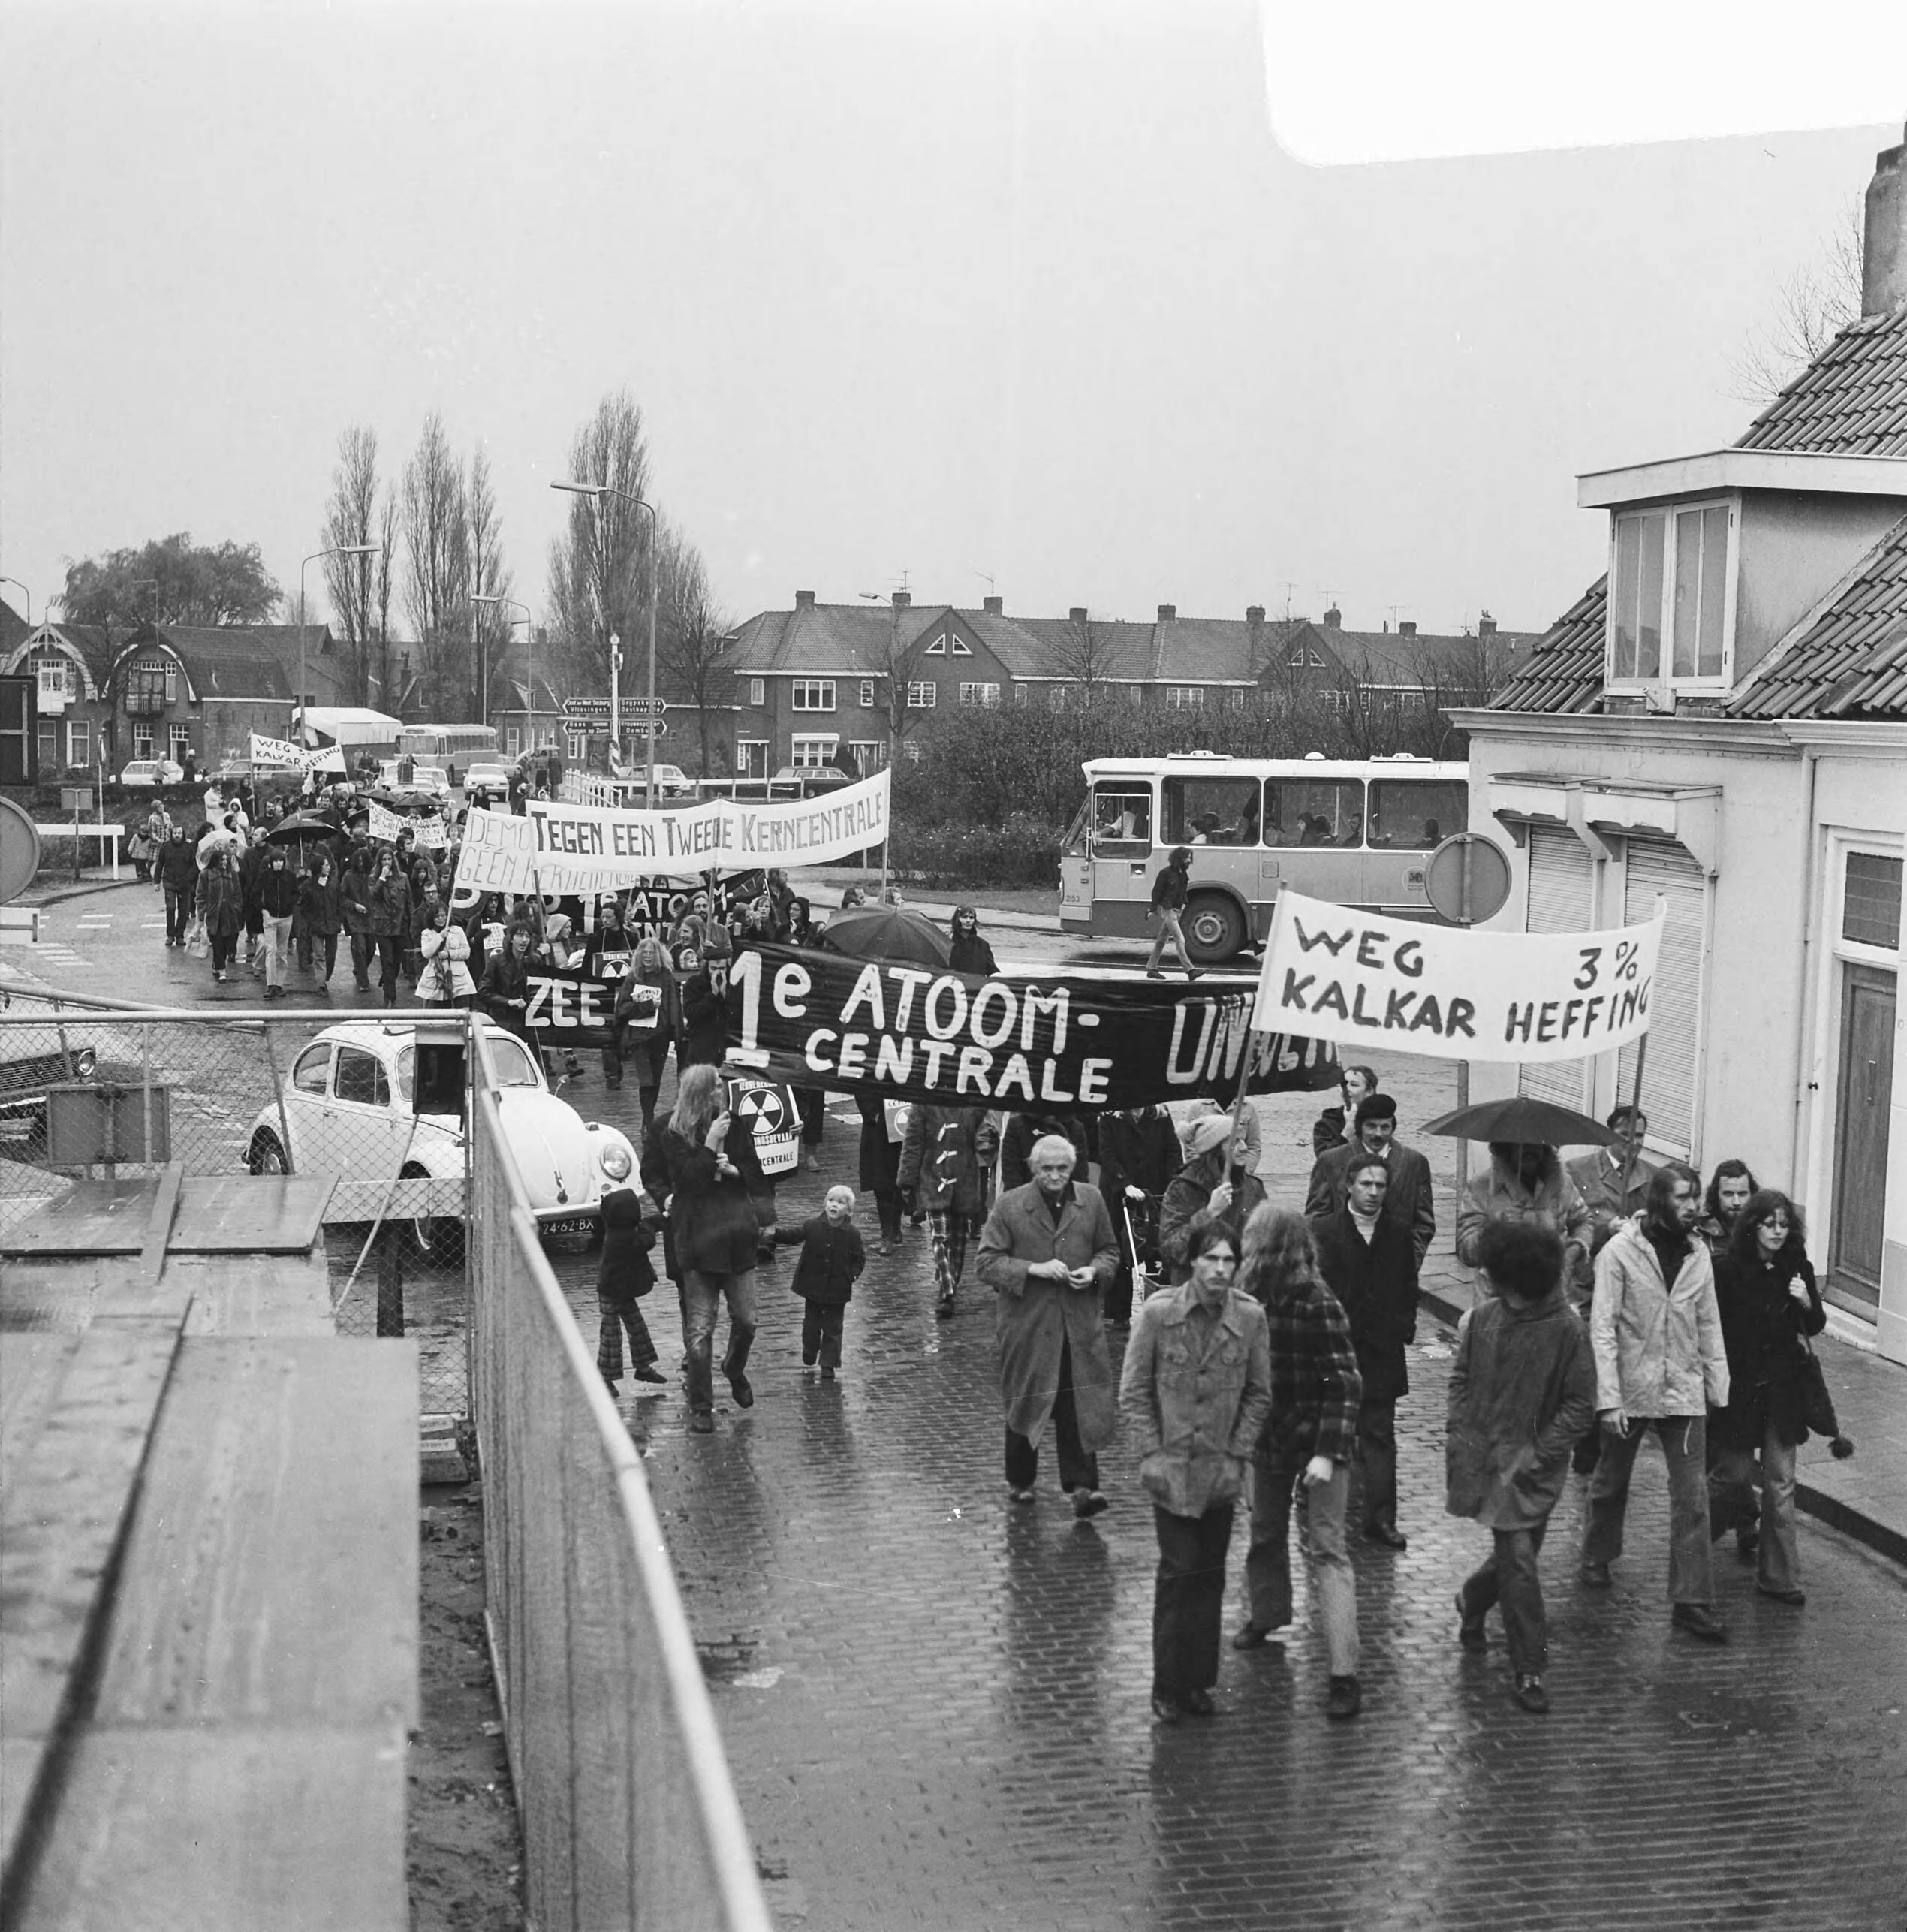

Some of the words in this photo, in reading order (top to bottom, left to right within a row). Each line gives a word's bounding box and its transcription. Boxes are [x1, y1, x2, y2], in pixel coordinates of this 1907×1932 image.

[258, 738, 291, 752] WEG
[531, 811, 604, 854] TEGEN
[612, 823, 655, 857] EEN
[662, 816, 734, 856] TWEEDE
[741, 791, 882, 853] KERNCENTRALE
[1294, 915, 1424, 977] WEG
[1574, 947, 1602, 990] 3
[1614, 940, 1640, 981] %
[725, 951, 812, 1068] 1e
[839, 963, 1100, 1055] ATOOM-
[1281, 967, 1476, 1038] KALKAR
[1505, 975, 1651, 1044] HEFFING
[805, 1028, 1113, 1103] CENTRALE
[543, 1218, 594, 1235] 24-62-BX
